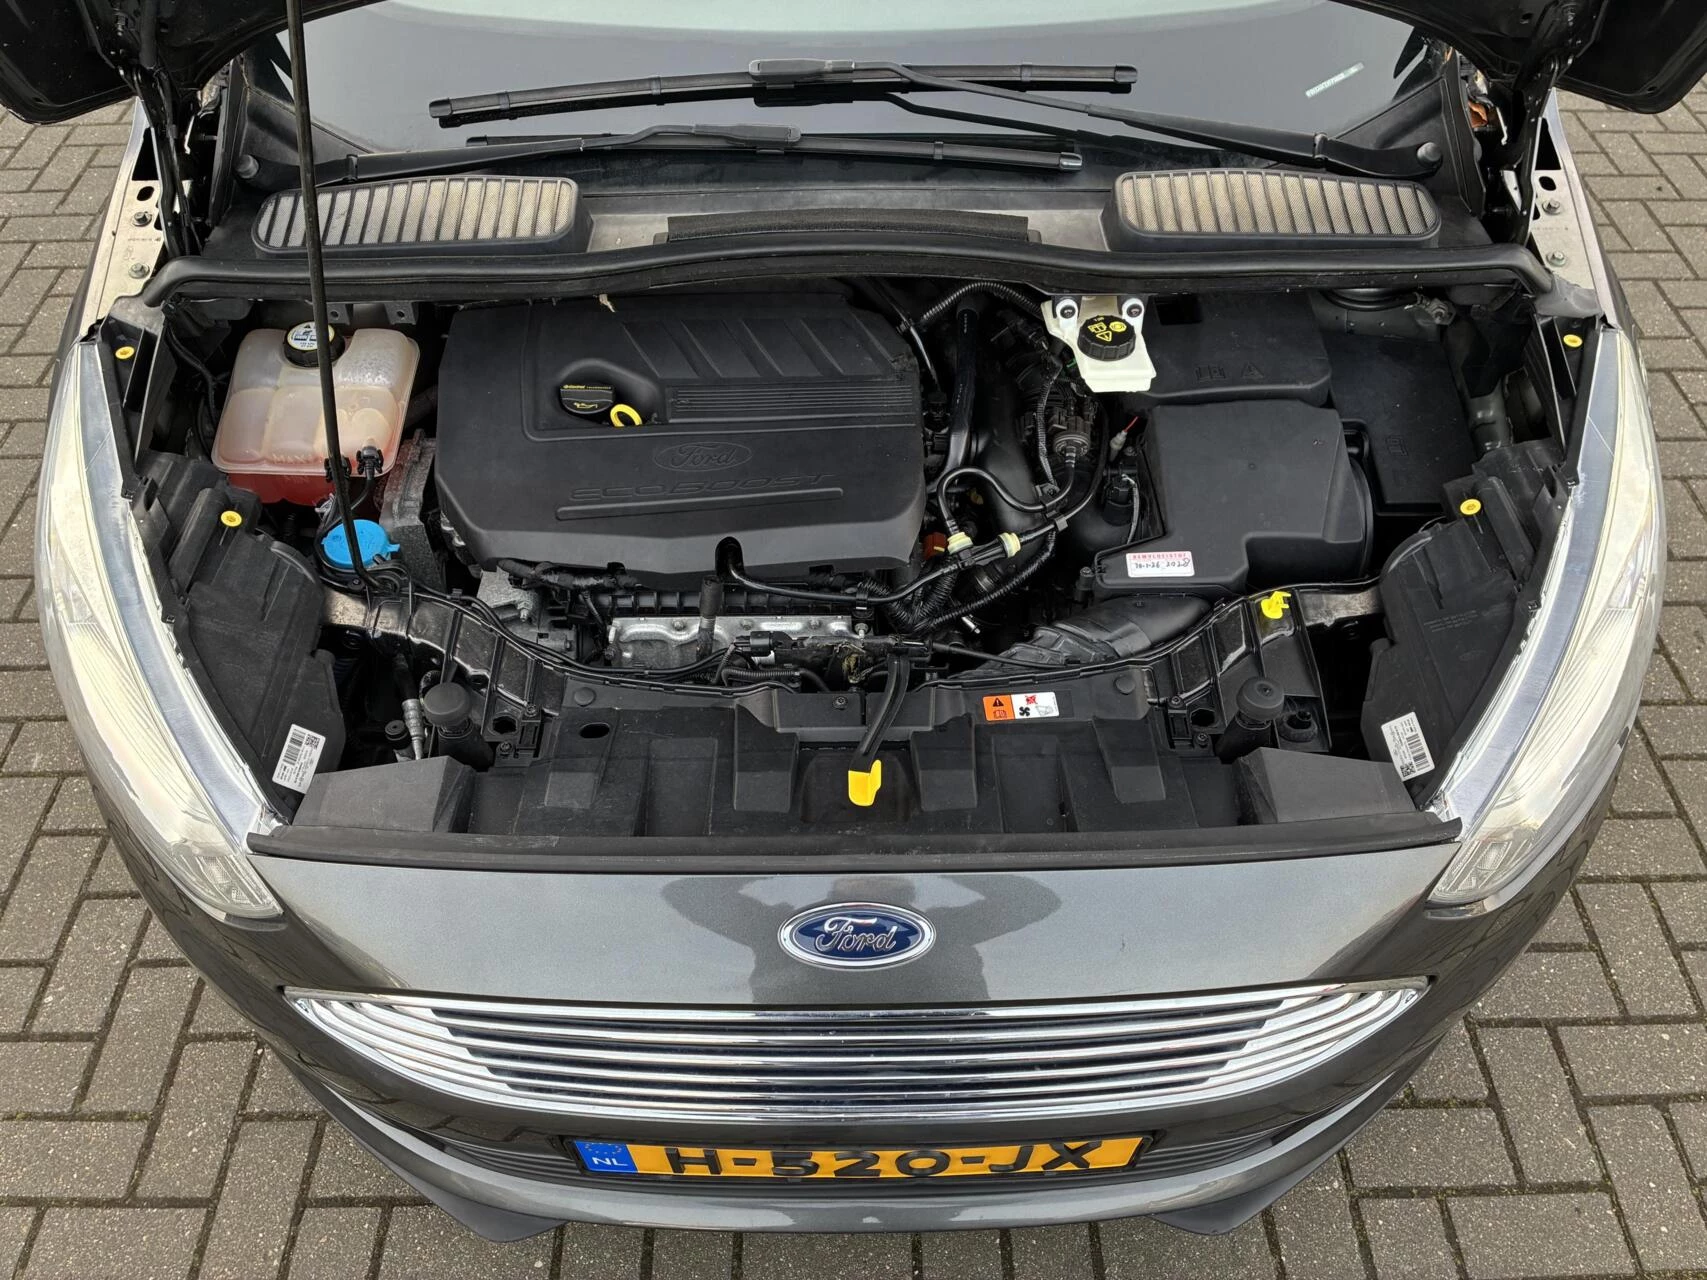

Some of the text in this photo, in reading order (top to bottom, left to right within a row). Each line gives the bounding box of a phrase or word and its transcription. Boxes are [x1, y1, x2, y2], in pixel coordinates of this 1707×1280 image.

[671, 444, 737, 467] Ford
[815, 915, 899, 952] Ford
[592, 1156, 628, 1167] NL
[664, 1140, 1102, 1177] H-520-JX
